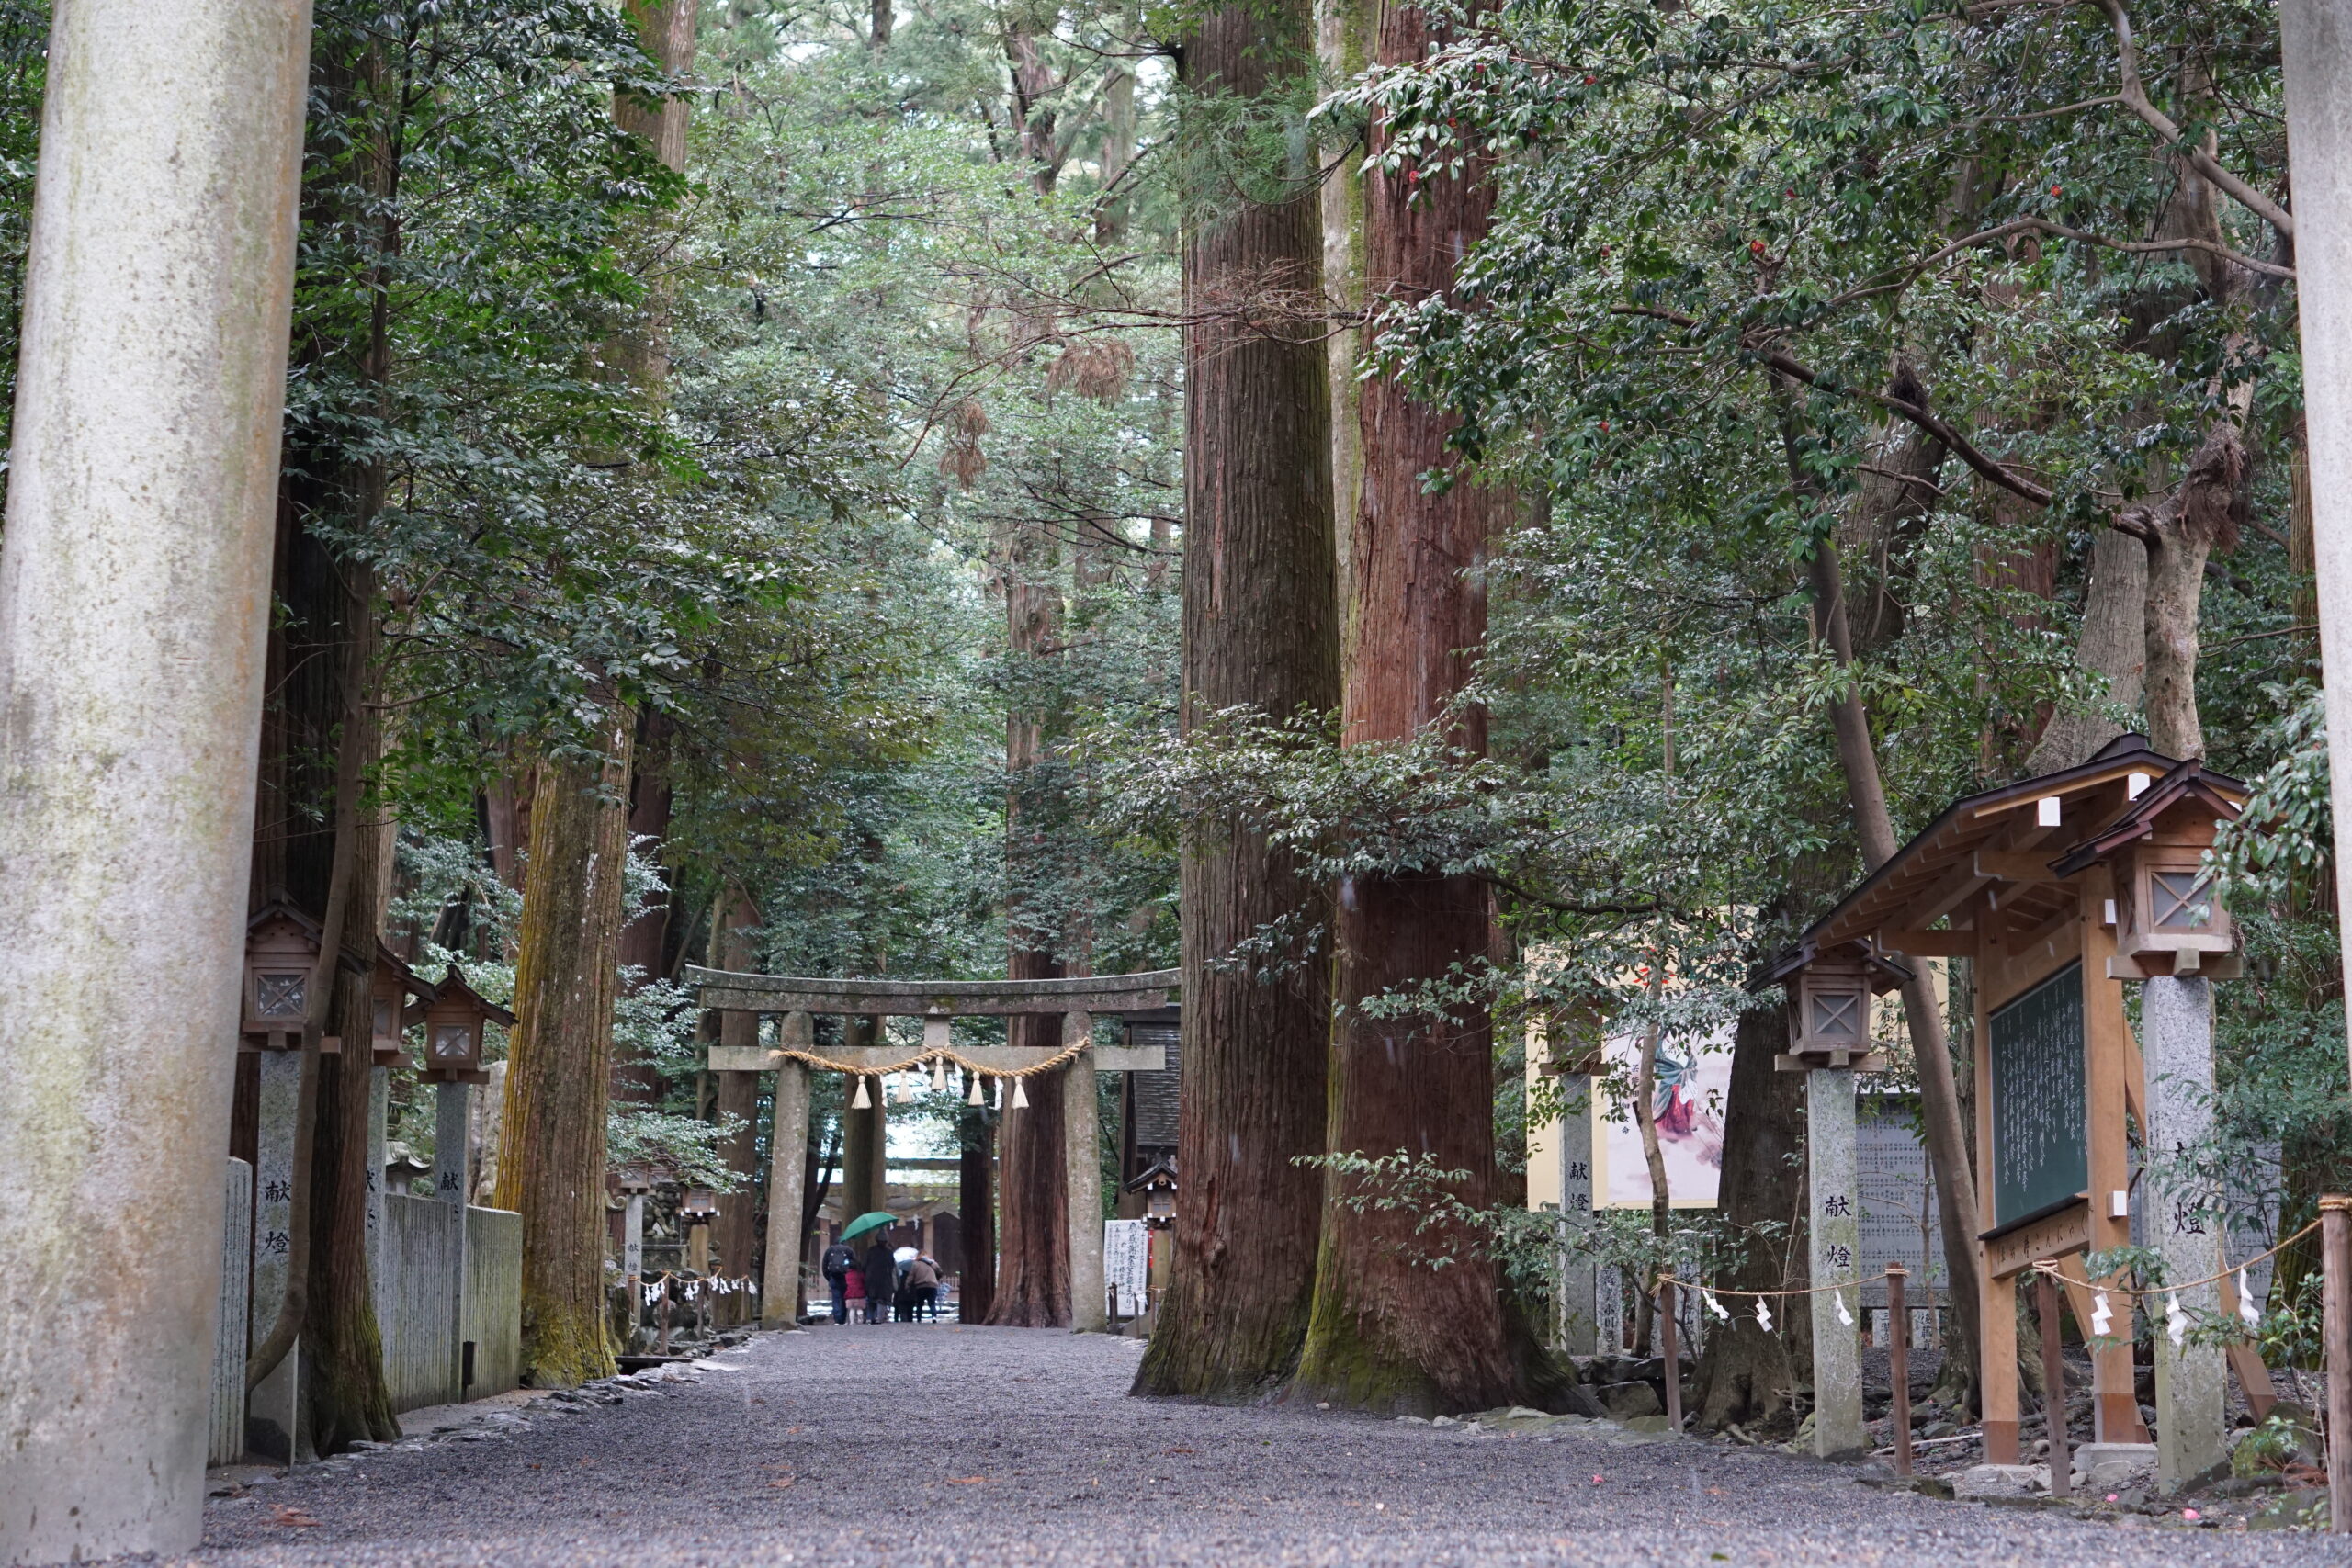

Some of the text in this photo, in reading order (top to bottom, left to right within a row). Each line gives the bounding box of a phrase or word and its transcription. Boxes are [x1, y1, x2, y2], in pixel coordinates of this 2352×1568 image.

[265, 1180, 291, 1254] 献燈
[1568, 1162, 1589, 1212] 献燈
[628, 1243, 639, 1271] 献燈
[1824, 1195, 1851, 1268] 献燈
